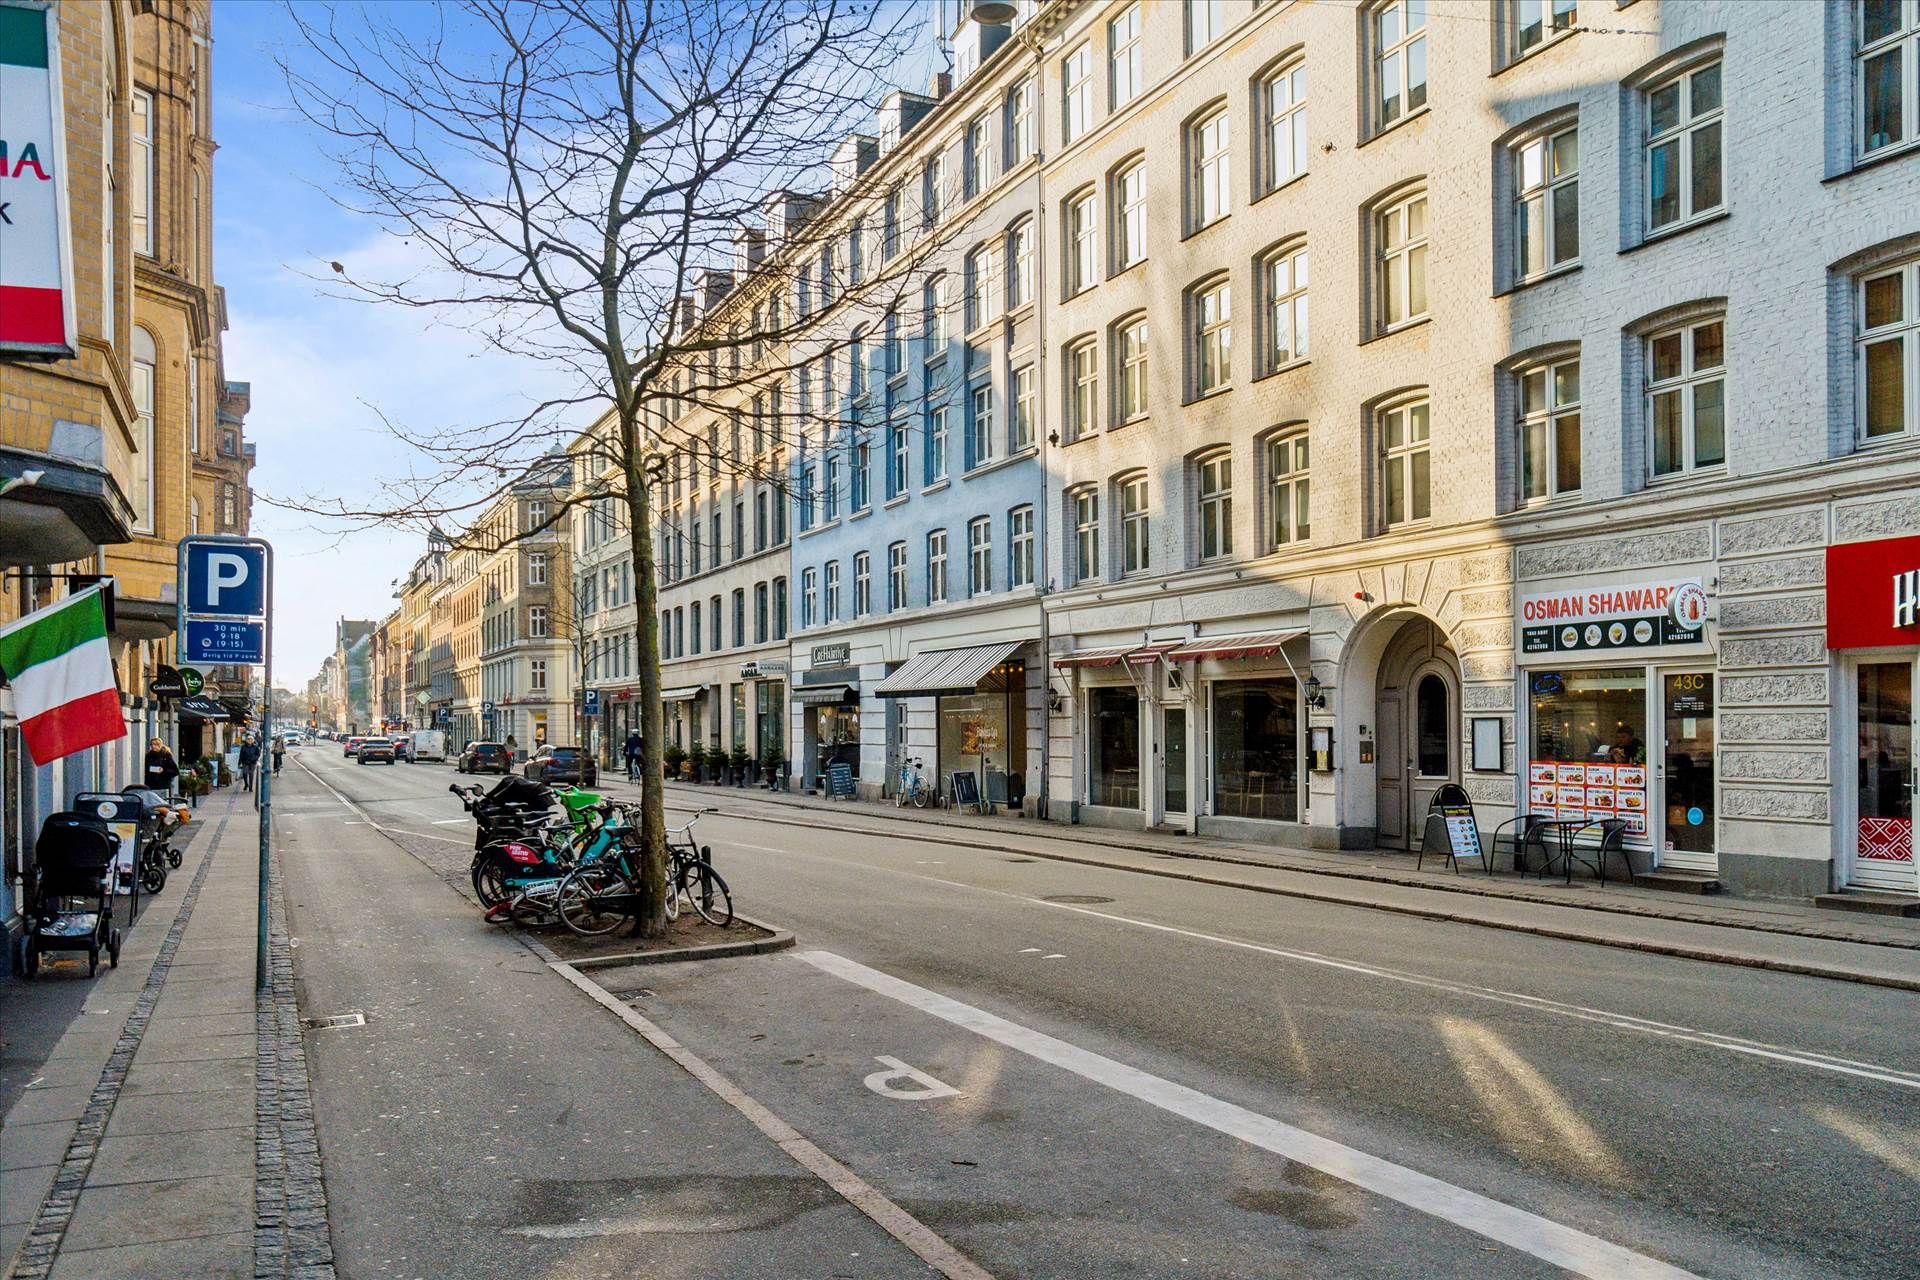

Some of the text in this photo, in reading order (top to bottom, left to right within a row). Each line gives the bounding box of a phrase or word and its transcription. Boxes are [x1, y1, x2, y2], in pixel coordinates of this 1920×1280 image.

[207, 552, 249, 607] P
[1523, 595, 1584, 622] OSMAN
[214, 624, 227, 632] 30
[1673, 674, 1705, 690] 43C
[586, 690, 596, 704] P
[440, 708, 447, 716] P
[484, 703, 492, 713] P
[863, 1054, 962, 1101] P
